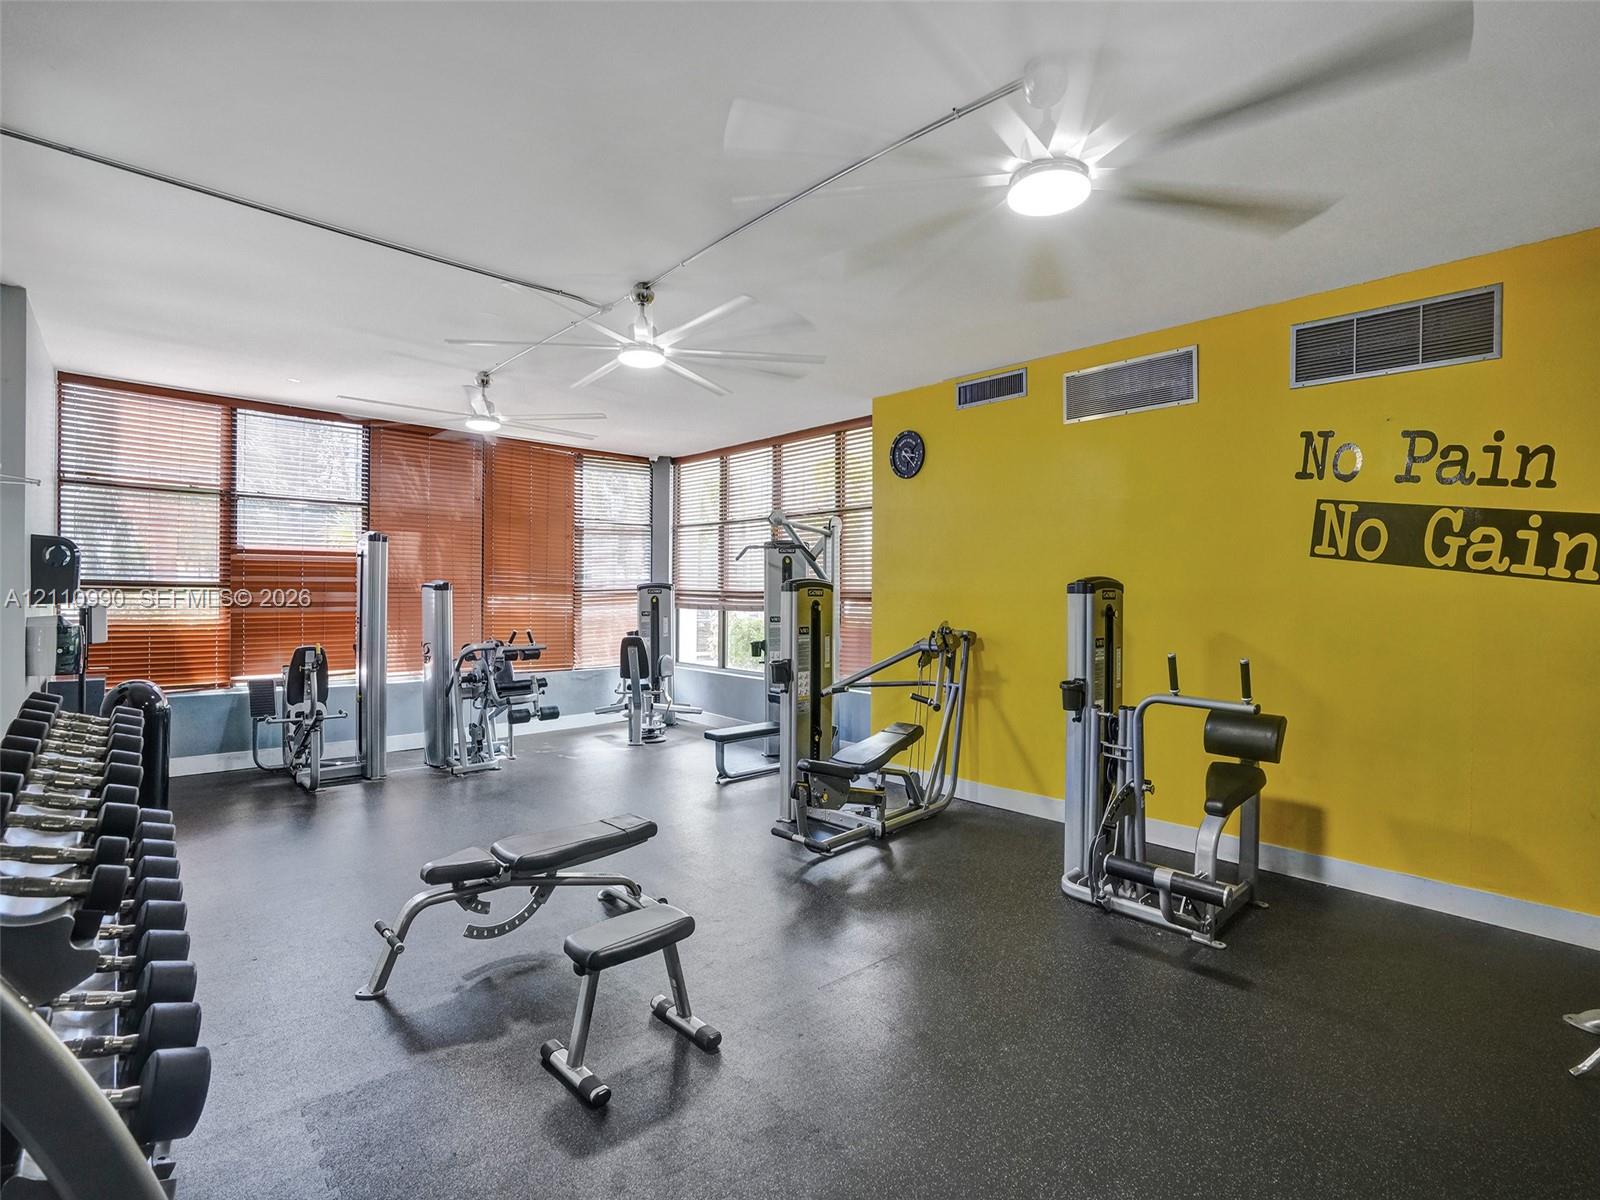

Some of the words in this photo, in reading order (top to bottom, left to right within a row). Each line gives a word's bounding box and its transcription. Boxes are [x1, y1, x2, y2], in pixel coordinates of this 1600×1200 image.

[1294, 429, 1363, 483] No
[1394, 429, 1557, 489] Pain
[1313, 502, 1389, 562] No
[1423, 507, 1600, 582] Gain
